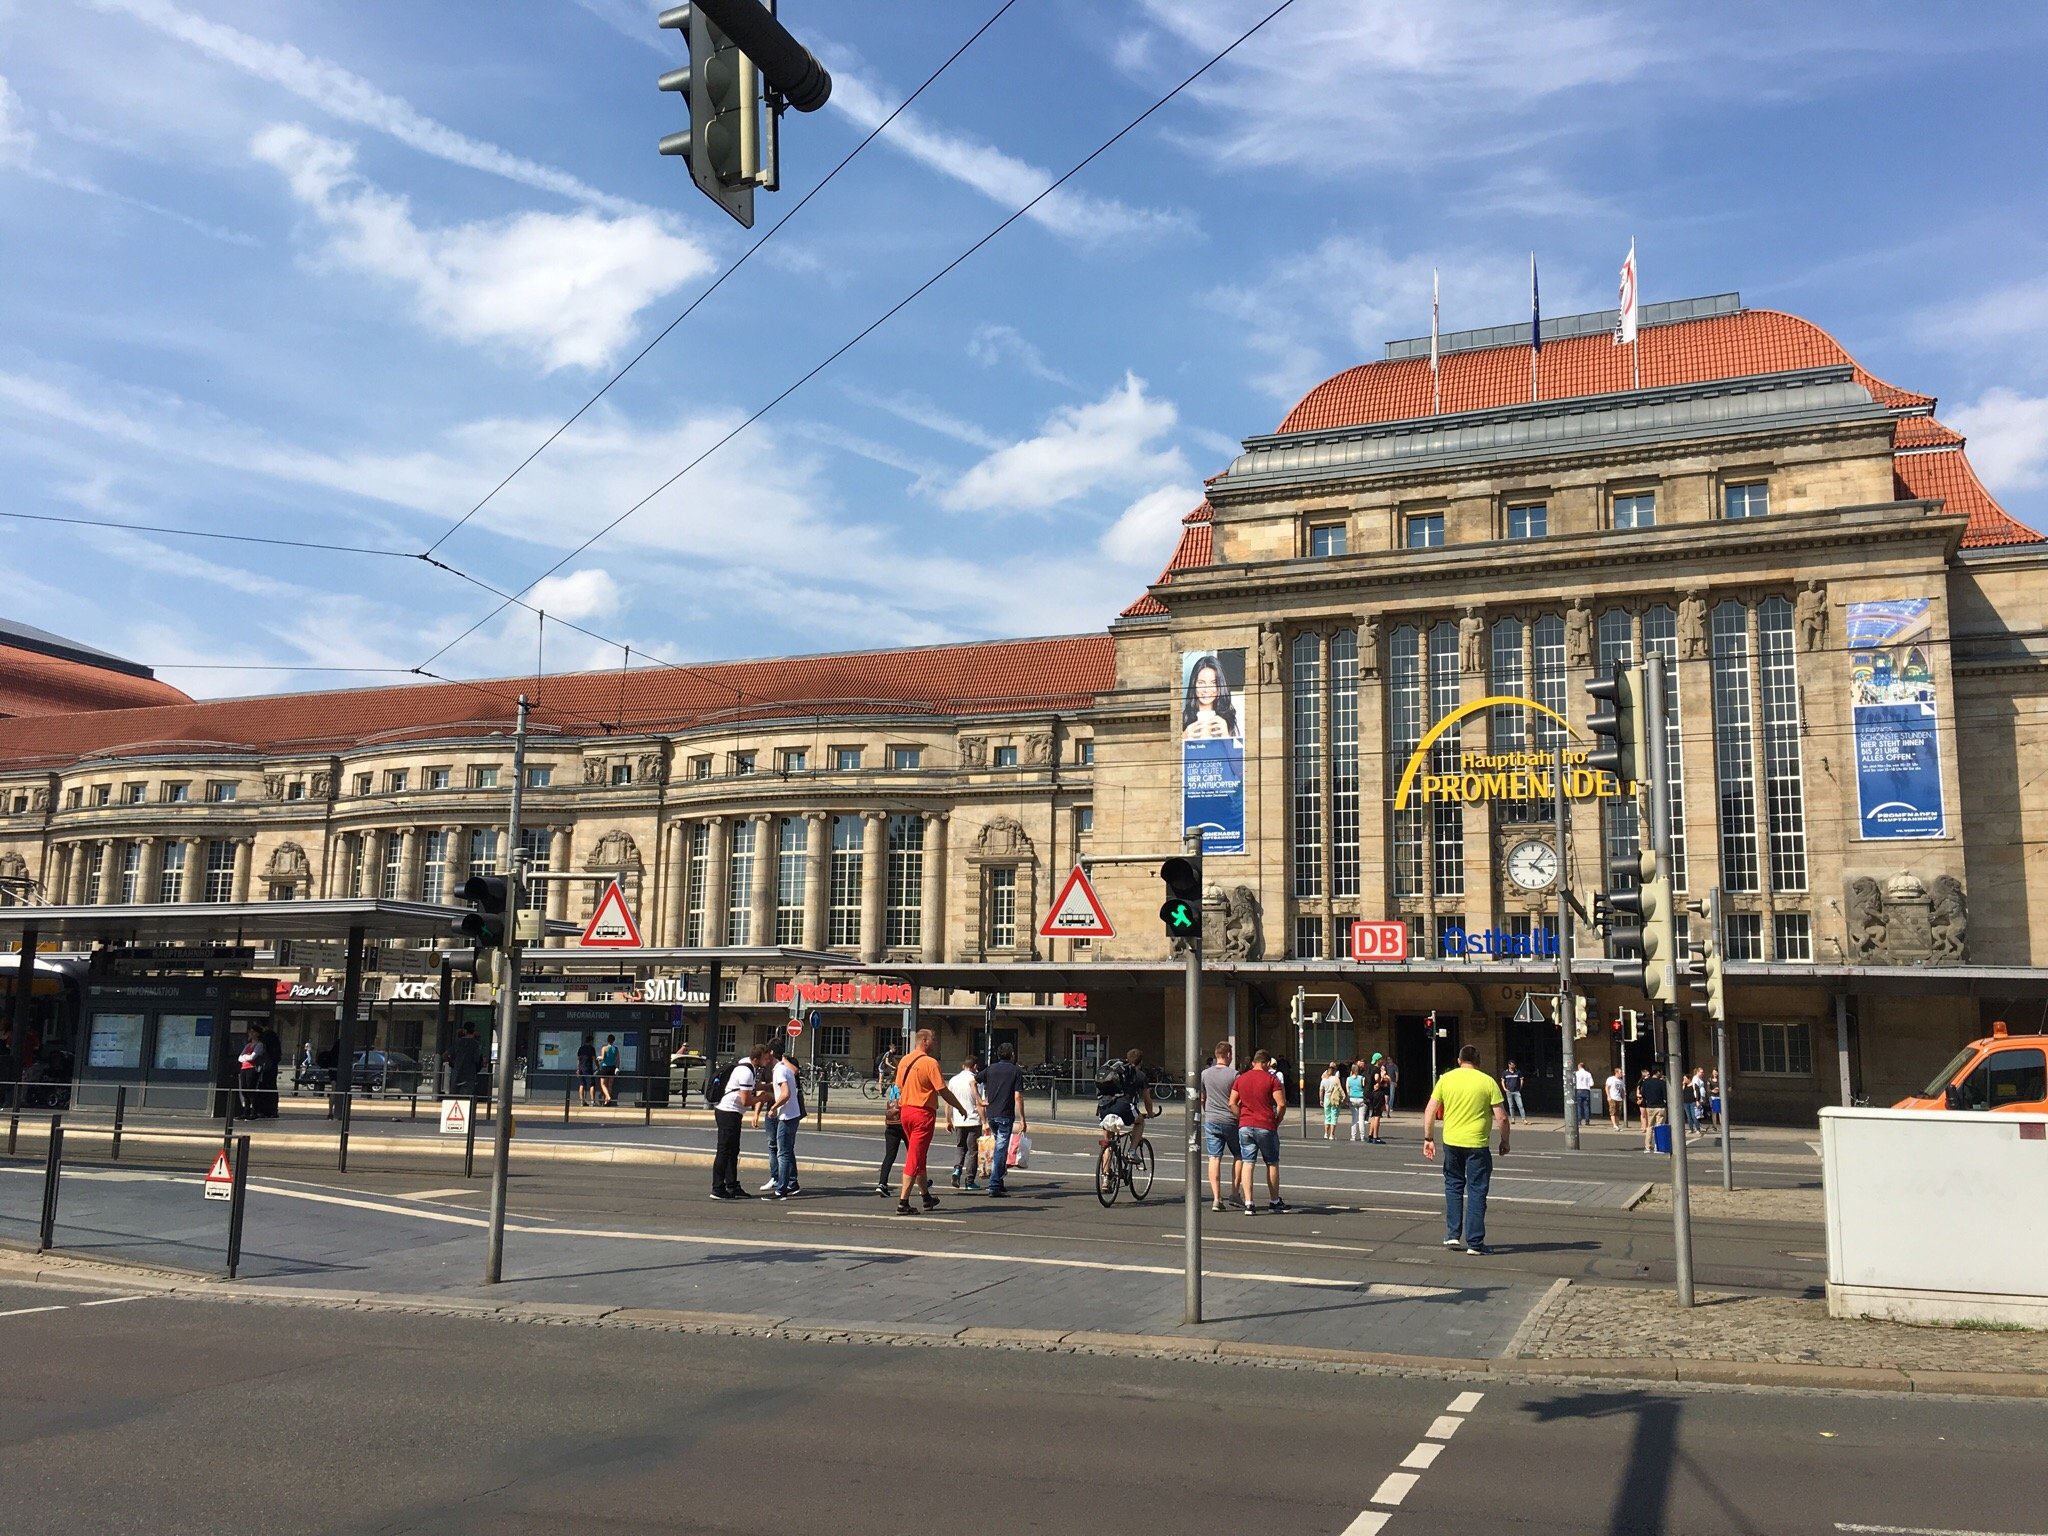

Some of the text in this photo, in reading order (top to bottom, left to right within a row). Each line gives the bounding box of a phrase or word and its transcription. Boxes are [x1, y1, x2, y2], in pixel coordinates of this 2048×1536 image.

[1879, 739, 1900, 747] STEHT
[1862, 754, 1884, 762] ALLES
[1358, 927, 1400, 954] DB
[550, 976, 604, 984] HAUPTBAHNHOF
[126, 985, 180, 996] INFORMATION
[289, 984, 334, 997] Pizza Hut
[393, 982, 437, 999] KFC
[860, 983, 912, 1004] KING
[566, 1011, 610, 1020] INFORMATION
